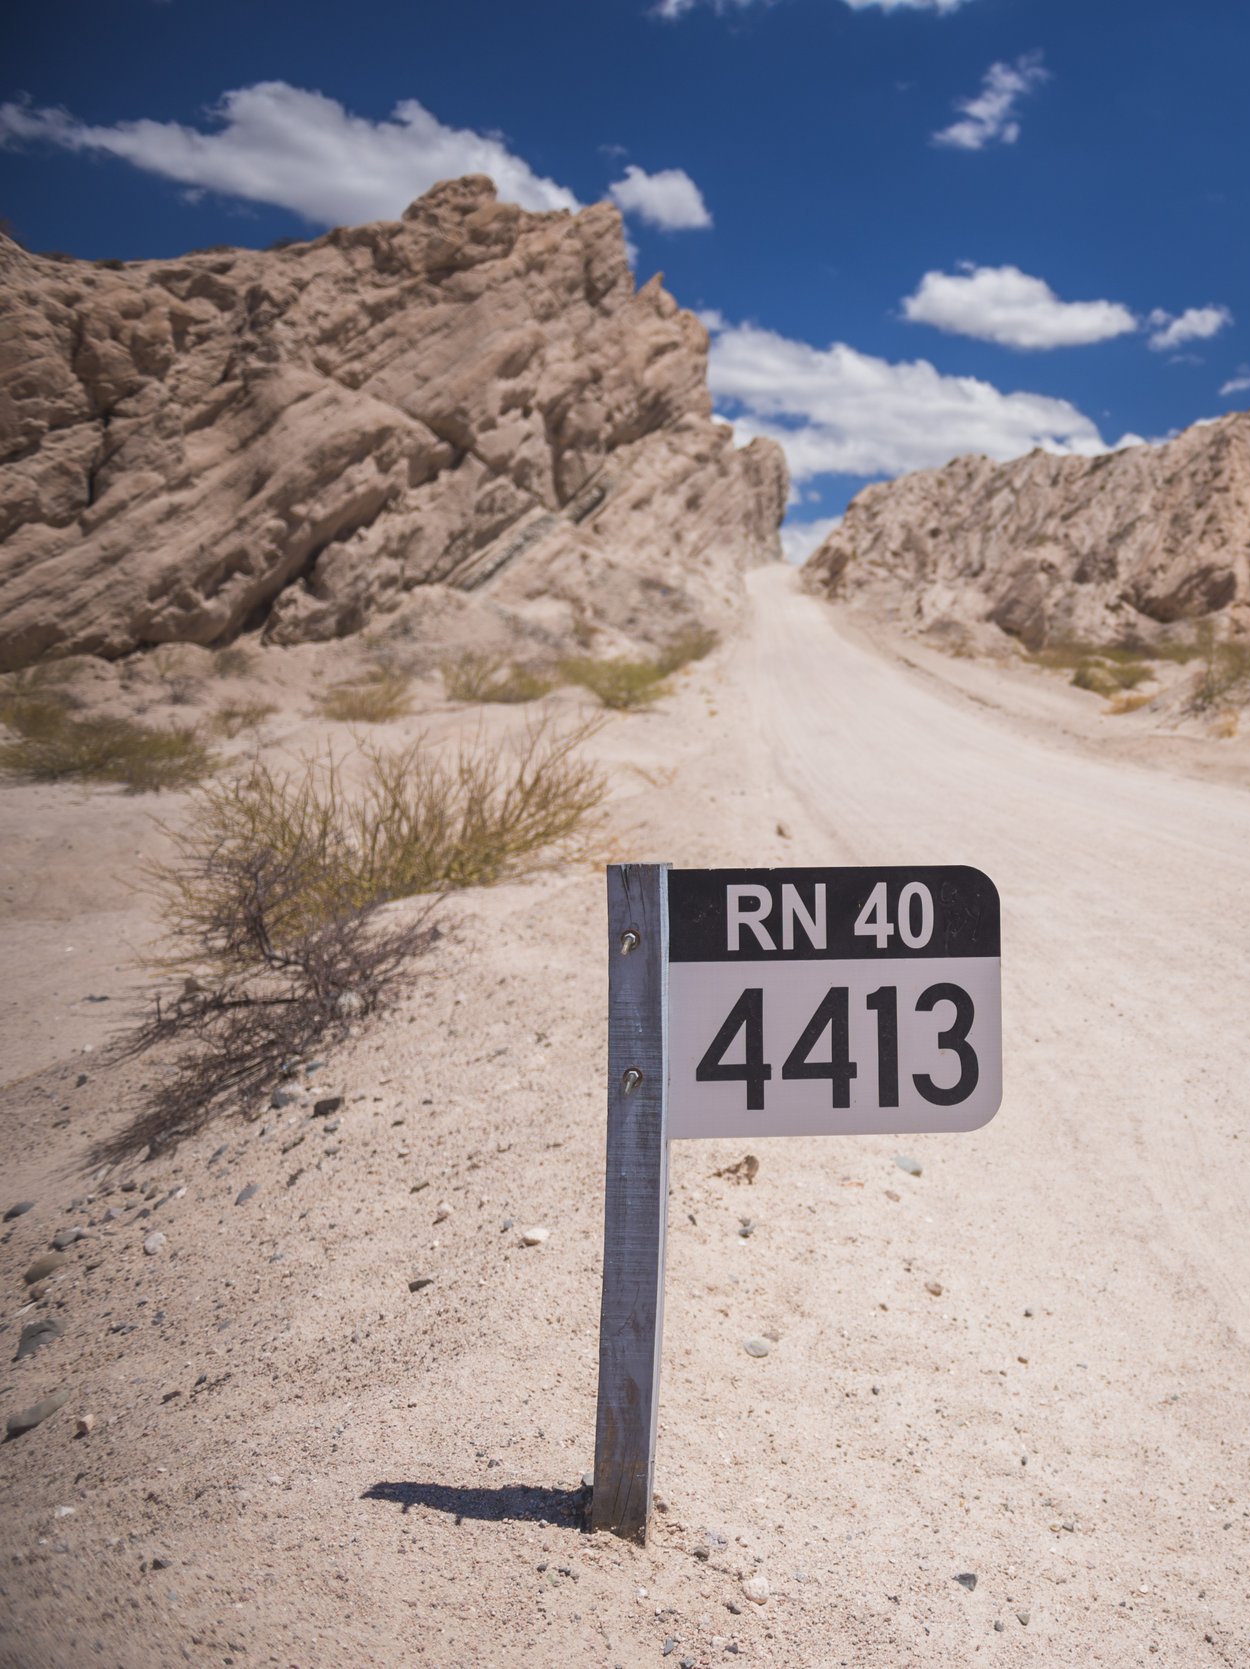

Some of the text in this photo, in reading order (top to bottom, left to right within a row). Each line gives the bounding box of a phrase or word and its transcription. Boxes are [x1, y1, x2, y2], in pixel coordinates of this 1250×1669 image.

[726, 881, 934, 951] RN 40
[695, 982, 980, 1110] 4413
